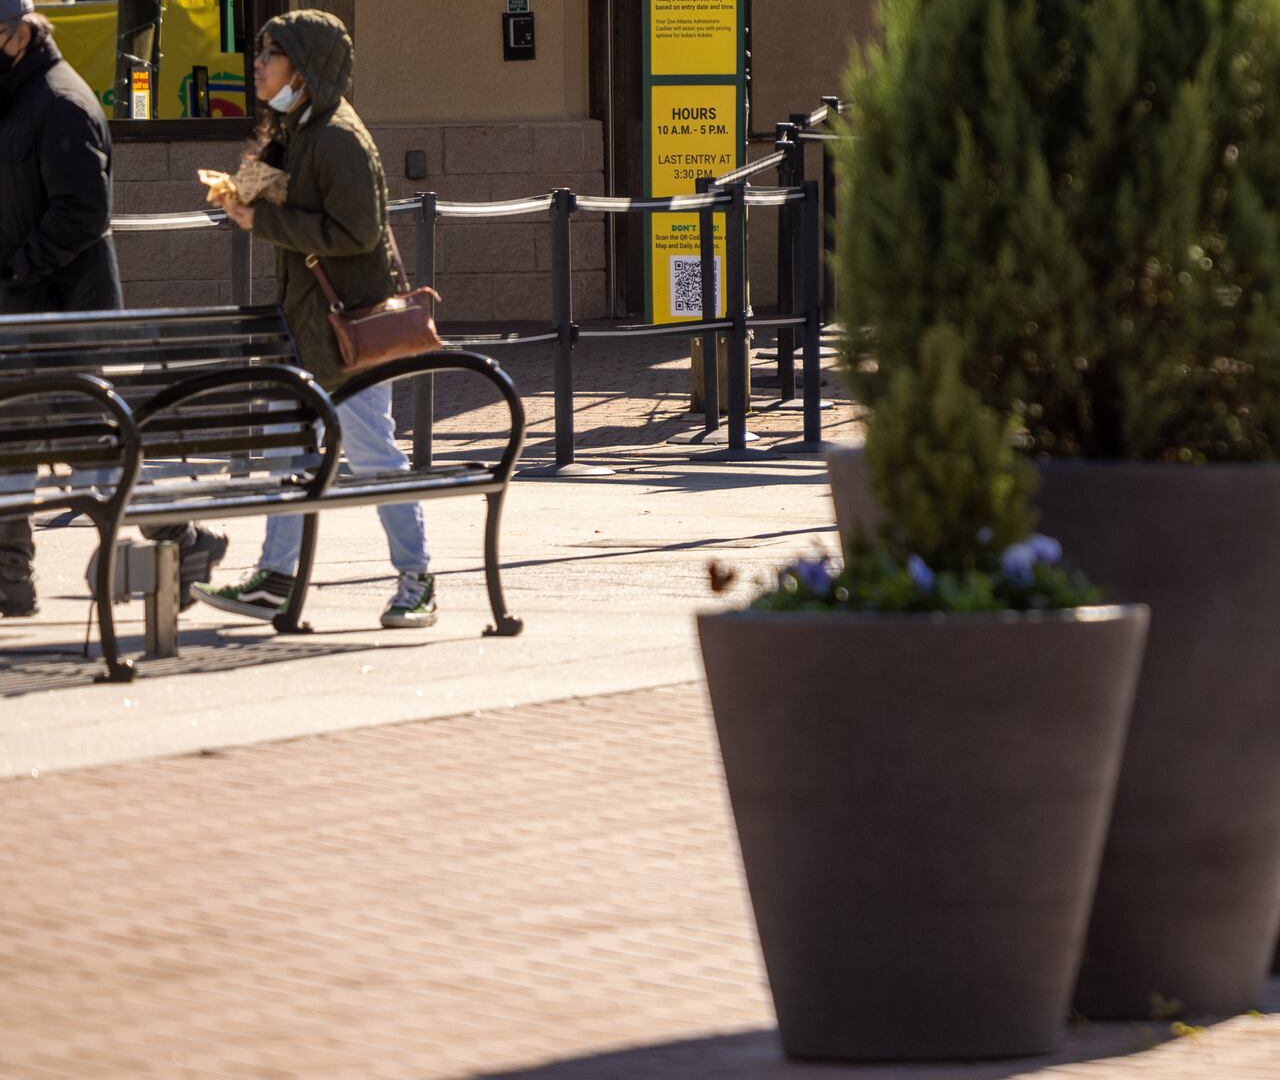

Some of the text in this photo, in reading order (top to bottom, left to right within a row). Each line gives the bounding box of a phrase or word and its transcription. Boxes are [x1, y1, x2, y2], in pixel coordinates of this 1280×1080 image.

[672, 108, 716, 120] HOURS
[658, 125, 668, 135] 10
[700, 125, 706, 134] 5
[709, 125, 728, 134] P.M.
[658, 154, 732, 164] LAST ENTRY AT
[674, 170, 694, 179] 3:30
